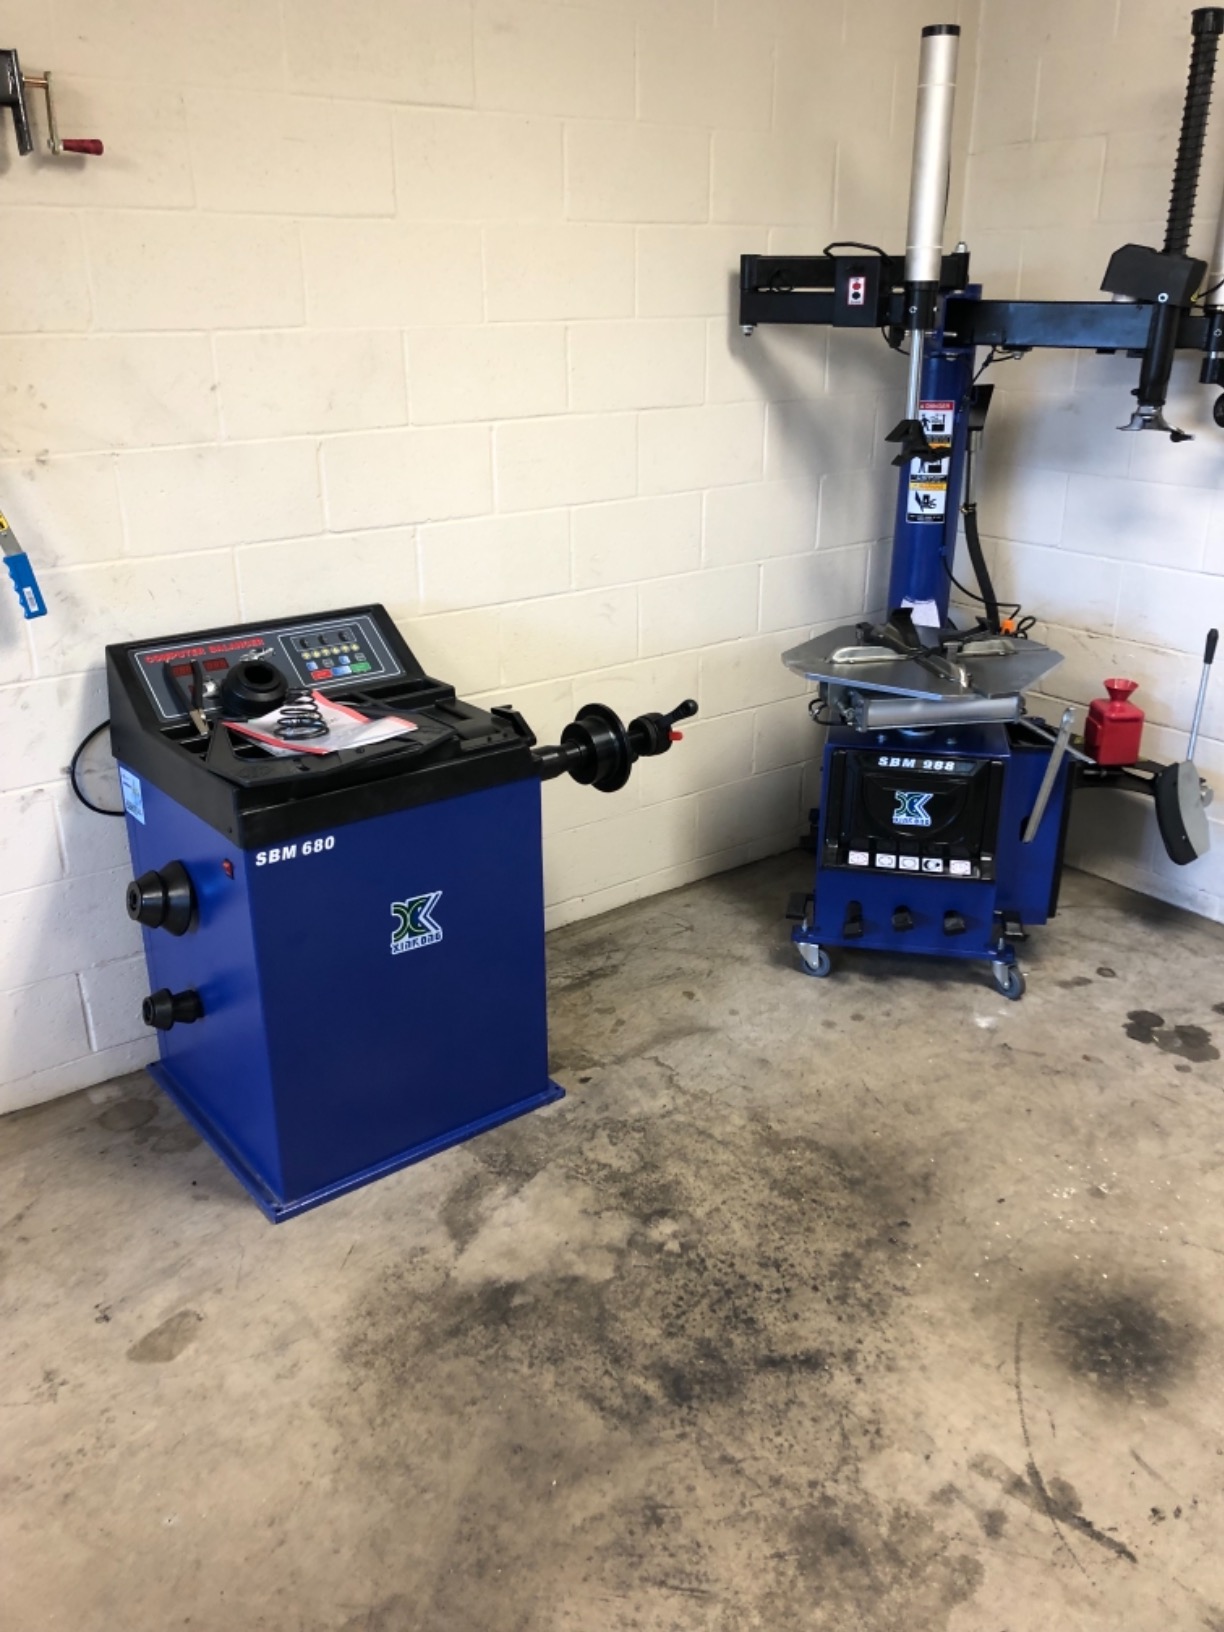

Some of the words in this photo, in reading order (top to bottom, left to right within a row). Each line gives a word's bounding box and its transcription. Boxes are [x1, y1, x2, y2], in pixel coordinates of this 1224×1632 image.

[144, 647, 206, 664] COMPUTER
[207, 637, 265, 654] BALANCER
[878, 756, 916, 768] SBM
[923, 759, 955, 771] 988
[255, 844, 297, 867] SBM
[301, 835, 335, 856] 680
